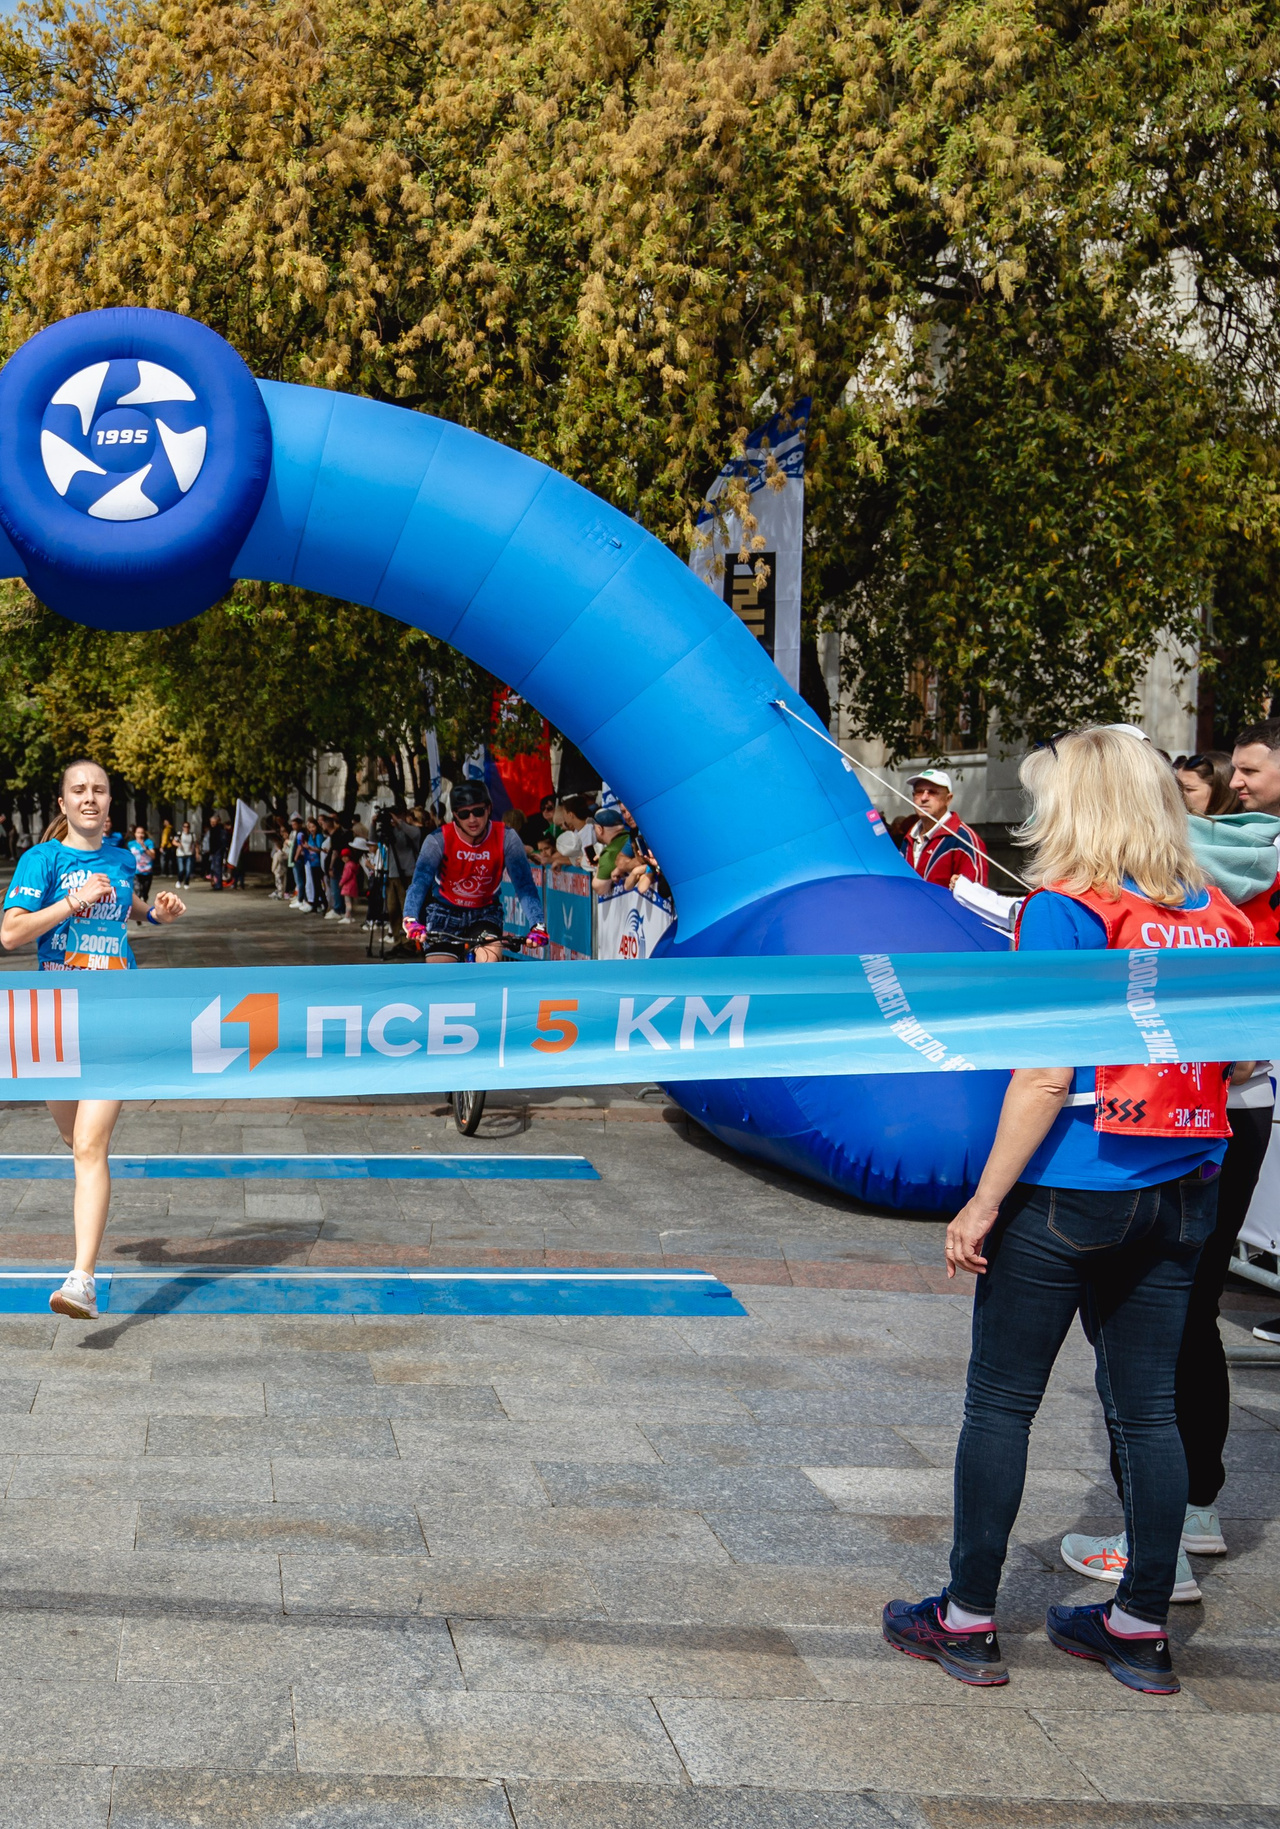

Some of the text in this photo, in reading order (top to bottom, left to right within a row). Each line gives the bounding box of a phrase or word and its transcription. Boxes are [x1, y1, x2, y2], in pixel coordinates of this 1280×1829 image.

[96, 429, 149, 446] 1995
[79, 933, 120, 955] 20075
[1141, 922, 1232, 949] СУДЬЯ
[306, 995, 751, 1058] ПСБ 5 КМ
[889, 1015, 949, 1063] #ЦЕЛЬ
